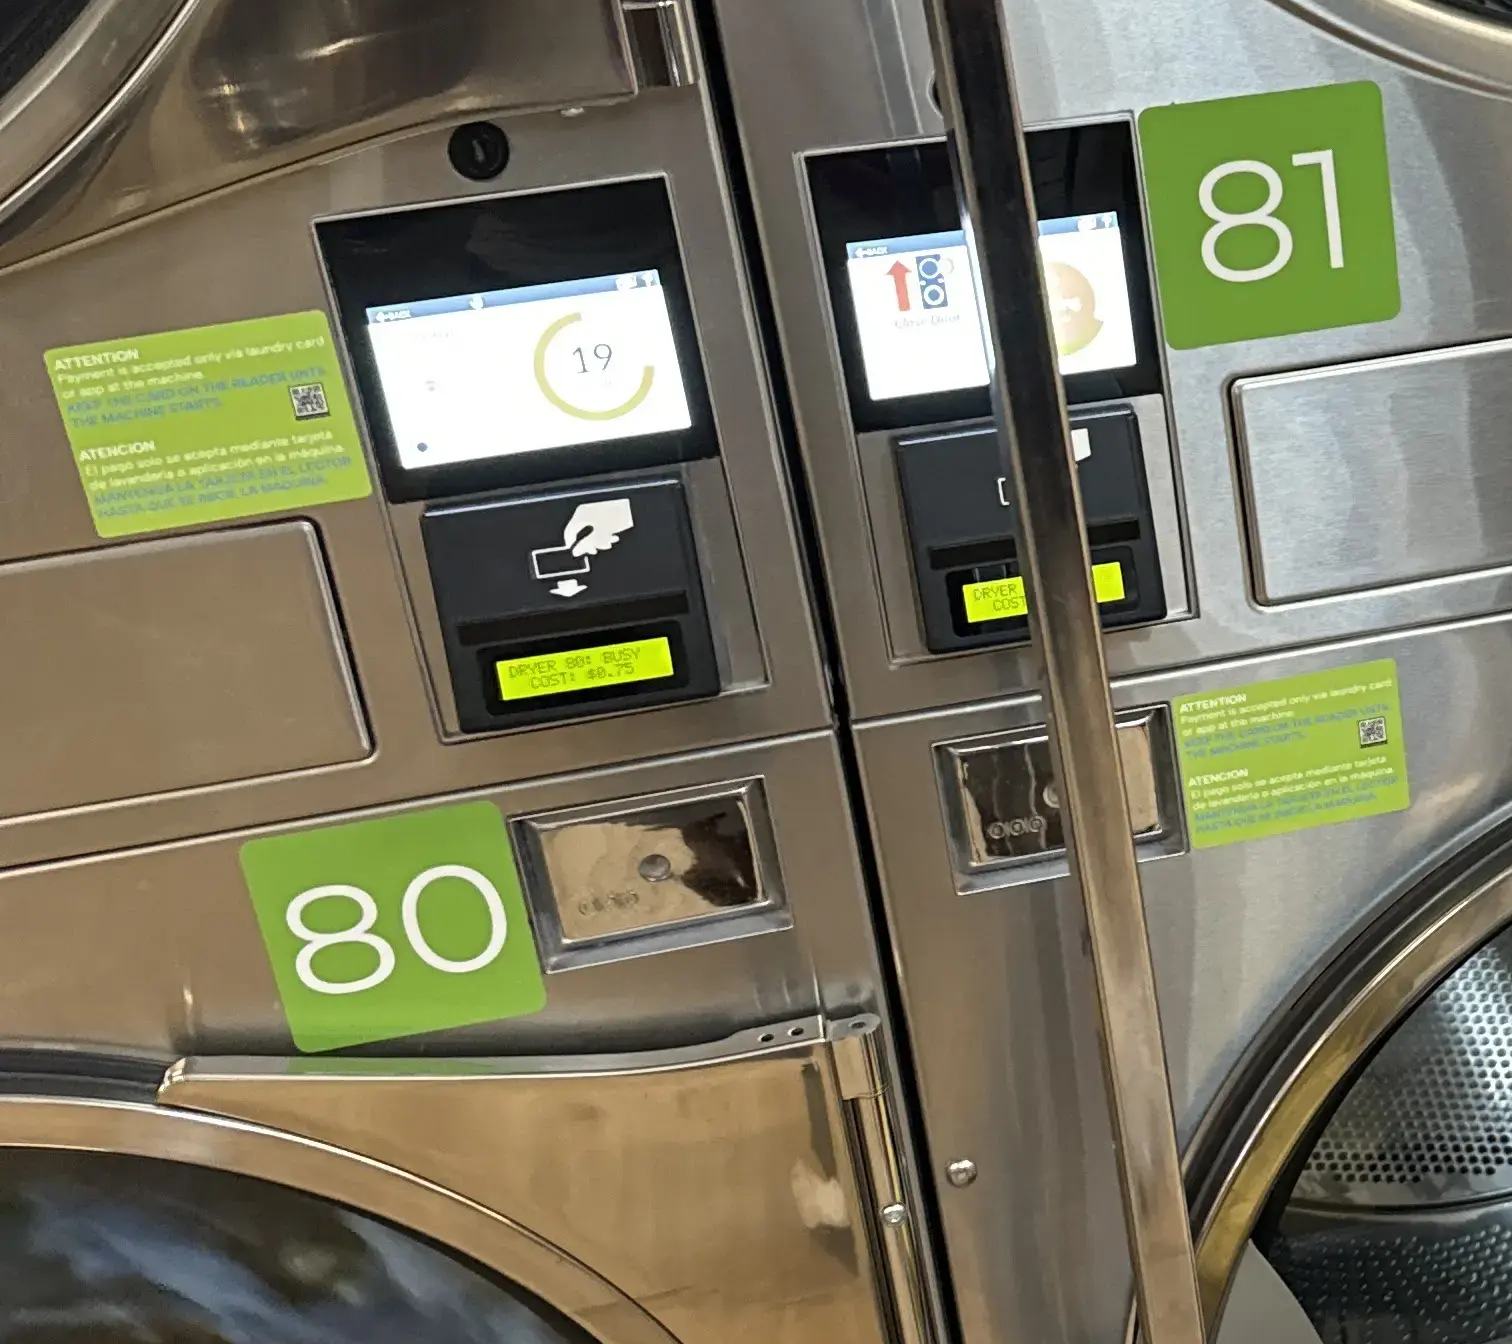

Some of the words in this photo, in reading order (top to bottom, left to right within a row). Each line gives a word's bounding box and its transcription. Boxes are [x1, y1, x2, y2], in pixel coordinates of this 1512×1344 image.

[1198, 149, 1346, 284] 81
[53, 348, 139, 370] ATTENTION
[572, 344, 612, 373] 19
[77, 440, 156, 462] ATENCION
[973, 584, 1017, 601] DRYER
[509, 660, 556, 679] DRYER
[565, 655, 591, 669] 80:
[602, 647, 640, 664] BUSY
[530, 672, 575, 689] COST:
[588, 662, 634, 680] $0.75
[1179, 693, 1246, 713] ATTENTION
[1188, 767, 1248, 786] ATENCION
[284, 863, 508, 996] 80
